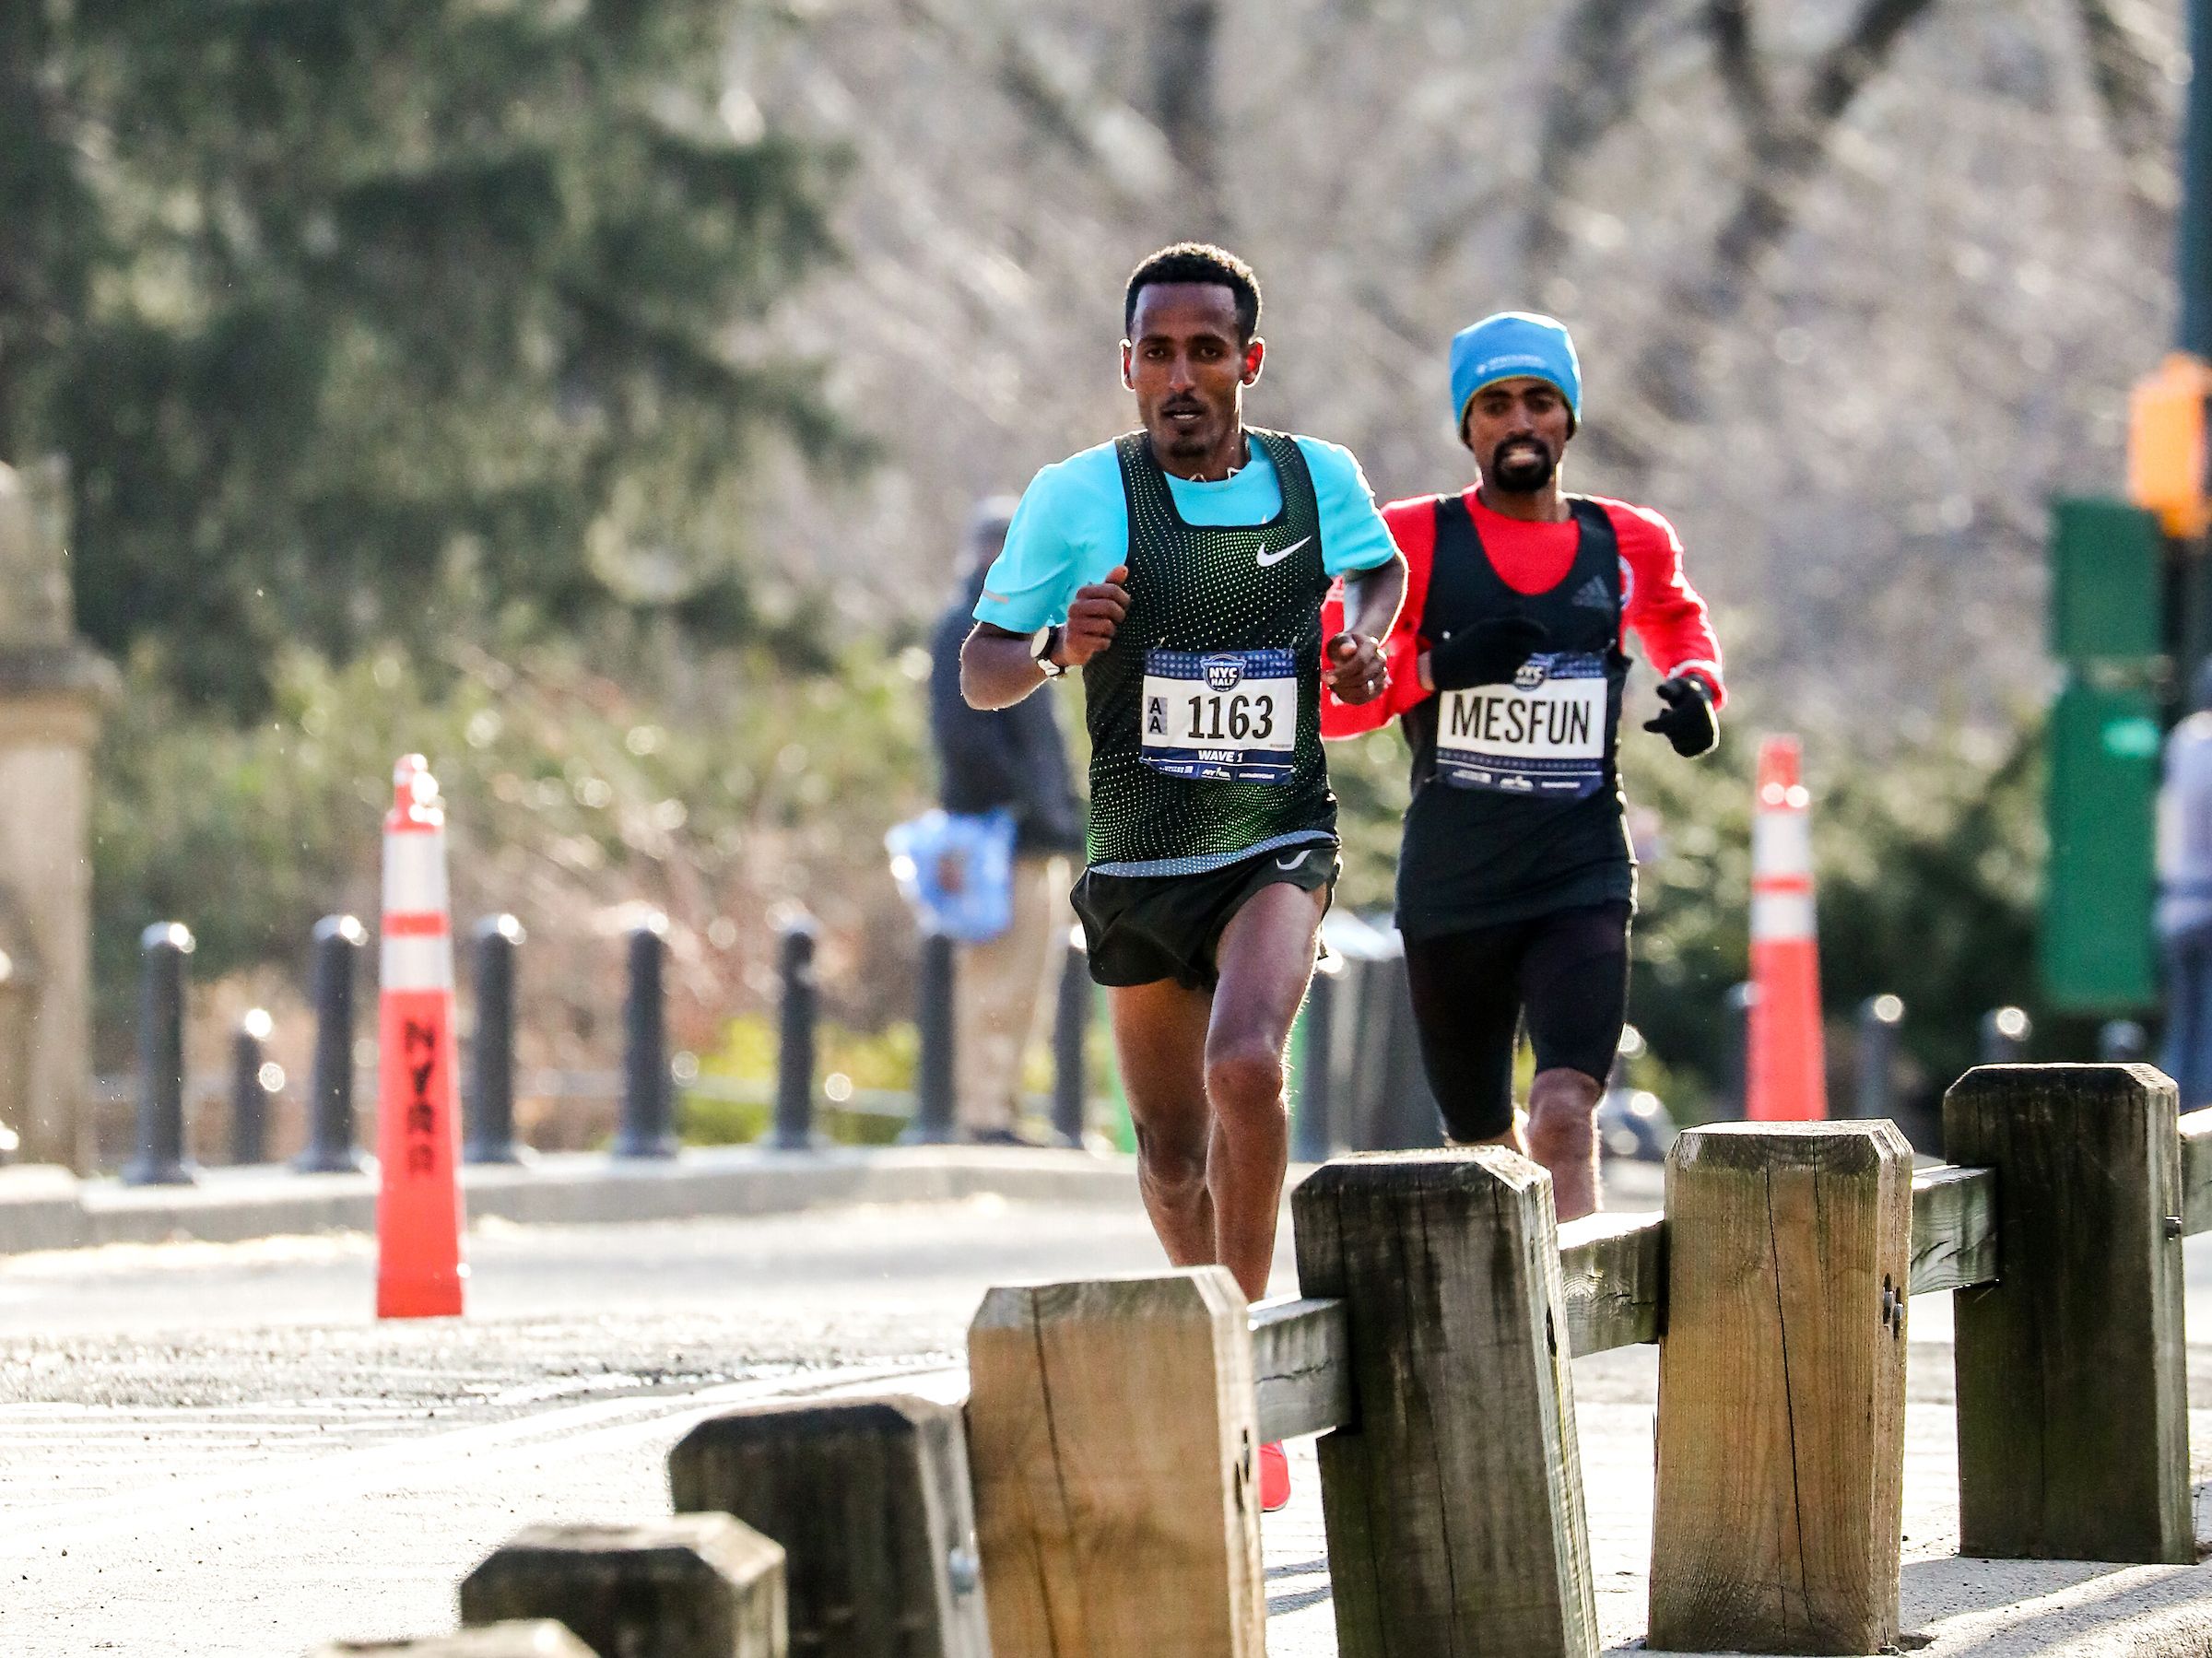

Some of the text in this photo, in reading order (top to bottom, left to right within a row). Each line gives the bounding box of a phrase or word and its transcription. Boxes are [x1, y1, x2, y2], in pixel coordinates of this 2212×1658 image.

[1209, 666, 1238, 678] NYC
[1211, 677, 1235, 687] HALF
[1188, 695, 1274, 740] 1163
[1451, 693, 1591, 745] MESFUN
[1198, 749, 1244, 763] WAVE 1
